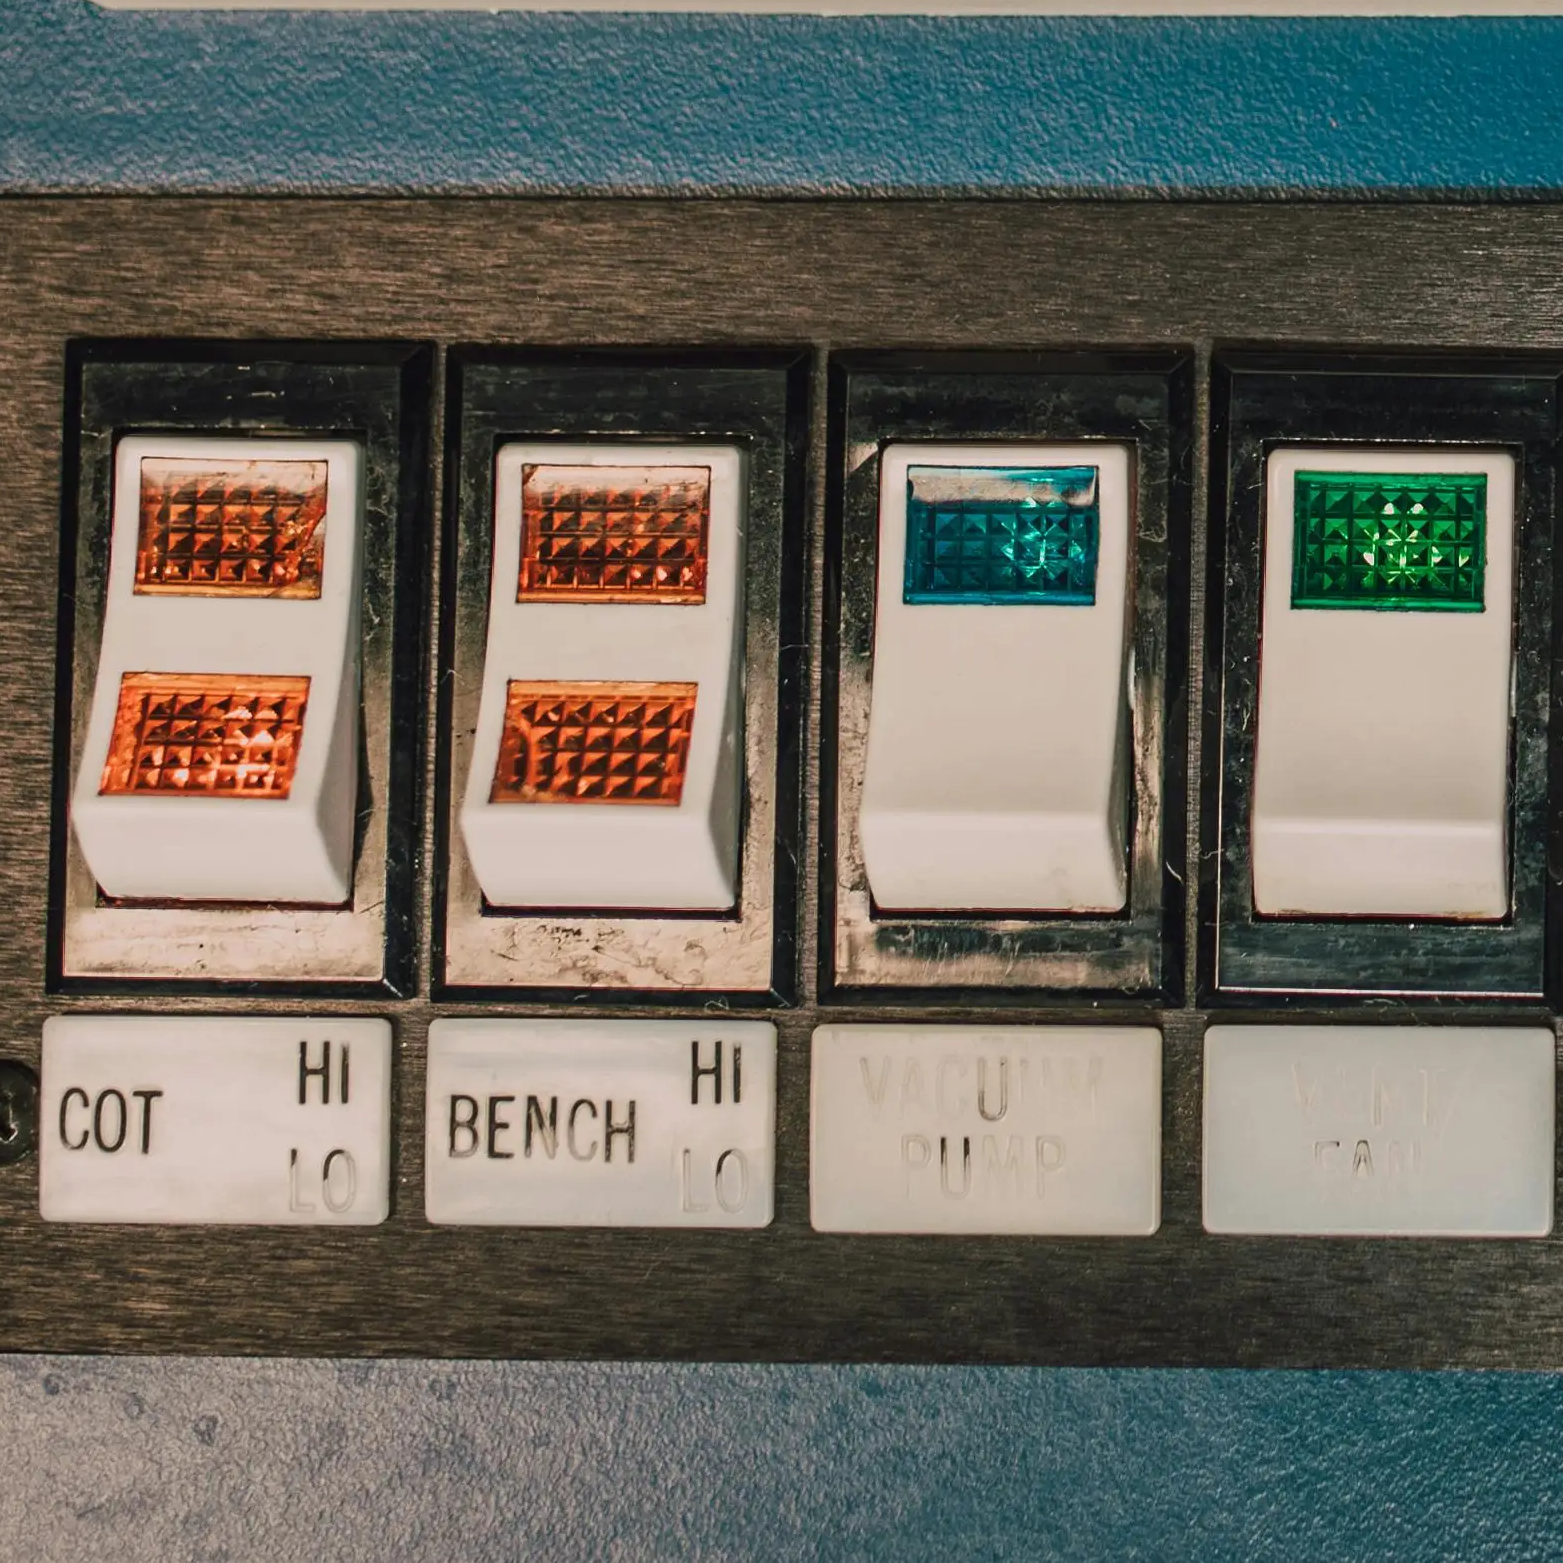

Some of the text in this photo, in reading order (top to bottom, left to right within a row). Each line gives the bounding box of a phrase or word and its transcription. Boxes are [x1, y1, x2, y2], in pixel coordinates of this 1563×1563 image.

[298, 1040, 350, 1105] HI
[690, 1040, 743, 1105] HI
[58, 1088, 163, 1155] COT
[448, 1094, 636, 1164] BENCH
[288, 1148, 357, 1214] LO
[680, 1147, 749, 1215] LO
[900, 1135, 1066, 1200] PUMP
